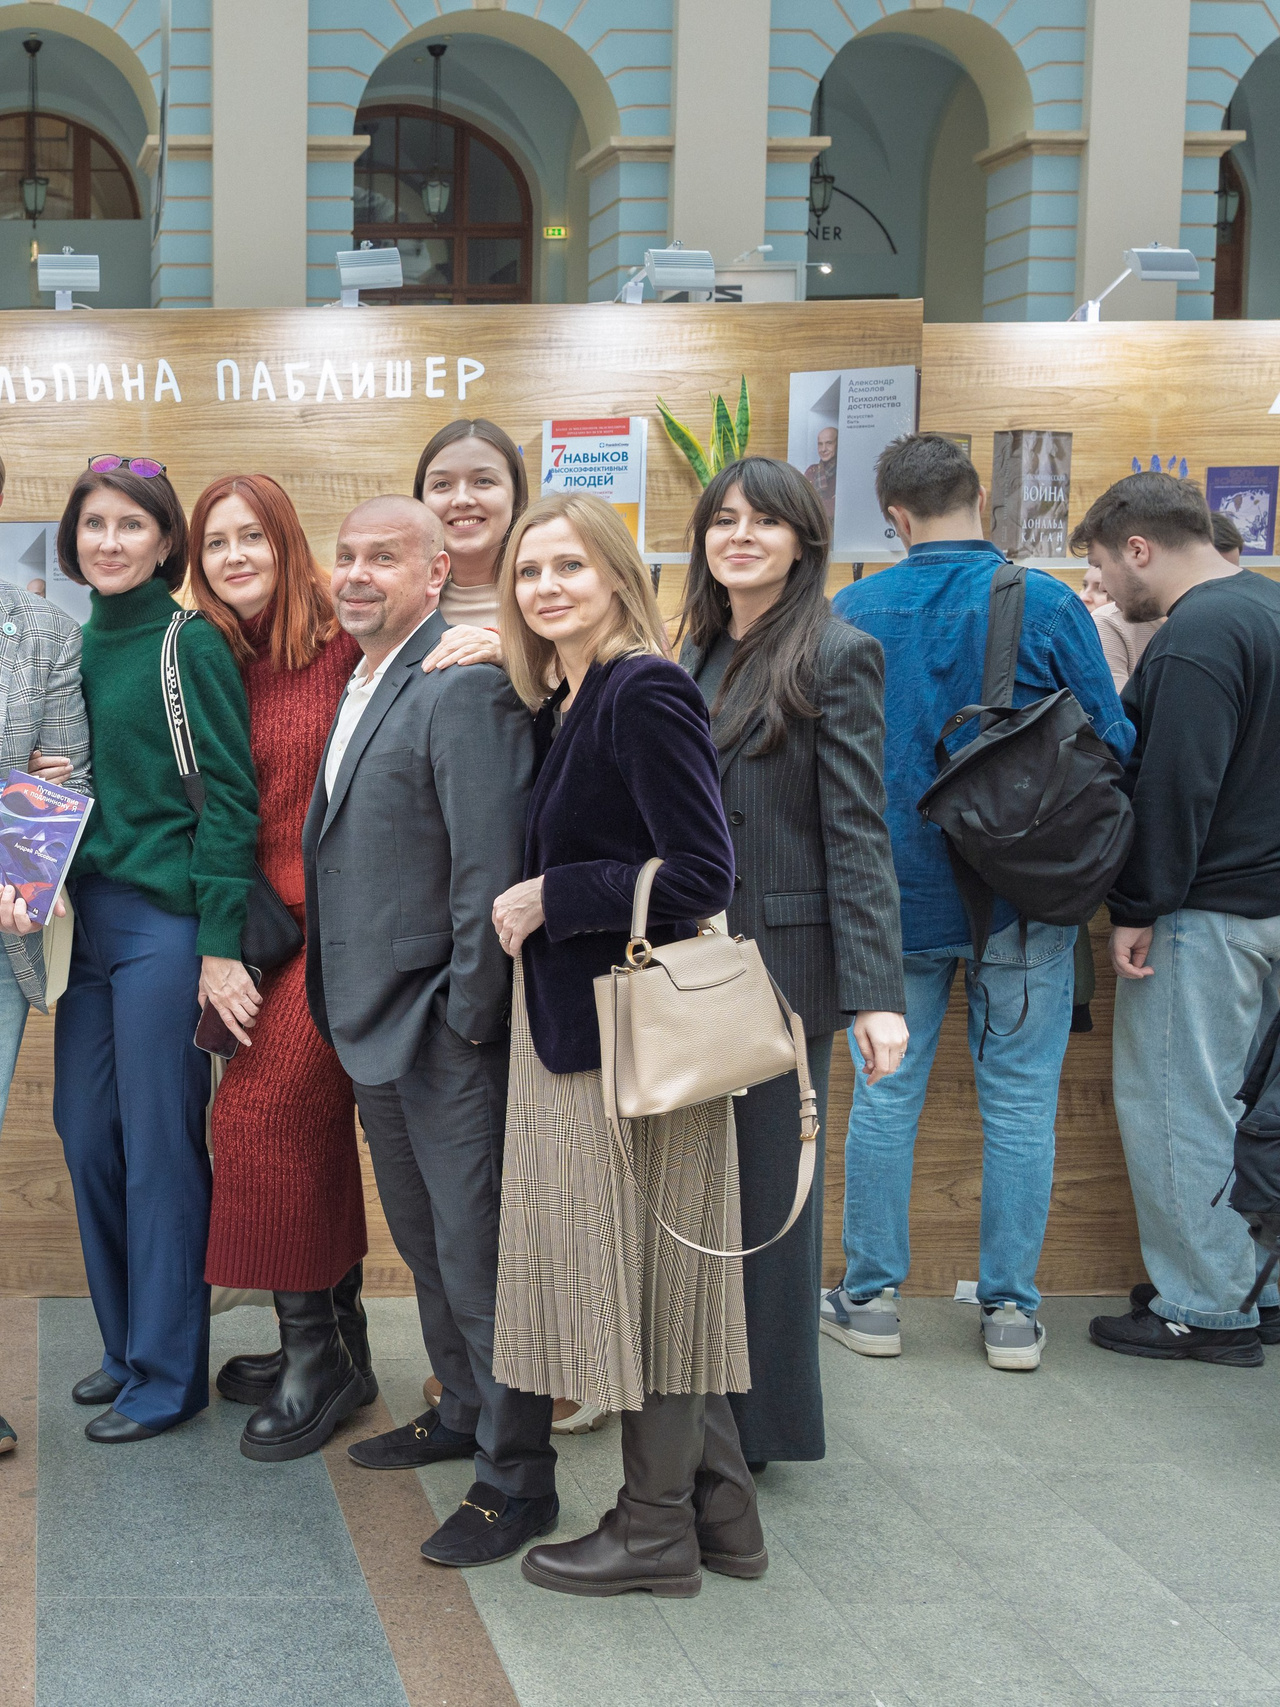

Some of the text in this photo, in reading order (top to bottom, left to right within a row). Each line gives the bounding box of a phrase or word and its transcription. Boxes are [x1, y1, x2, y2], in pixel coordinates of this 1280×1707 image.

[217, 356, 485, 402] ПАБЛИШЕР
[848, 378, 895, 387] Александр
[848, 395, 897, 403] Психология
[847, 402, 901, 411] достоинства
[551, 444, 629, 468] 7 НАВЫКОВ
[551, 465, 628, 474] ВЫСОКОЭФФЕКТИВНЫХ
[563, 472, 614, 488] ЛЮДЕЙ
[1023, 483, 1065, 502] ВОЙНА
[1021, 519, 1063, 530] ДОНАЛЬД
[1021, 532, 1063, 542] КАГАН
[166, 664, 184, 728] PRADA
[30, 791, 70, 810] подлинному
[36, 784, 79, 806] Путешествие
[14, 842, 34, 855] Андрей
